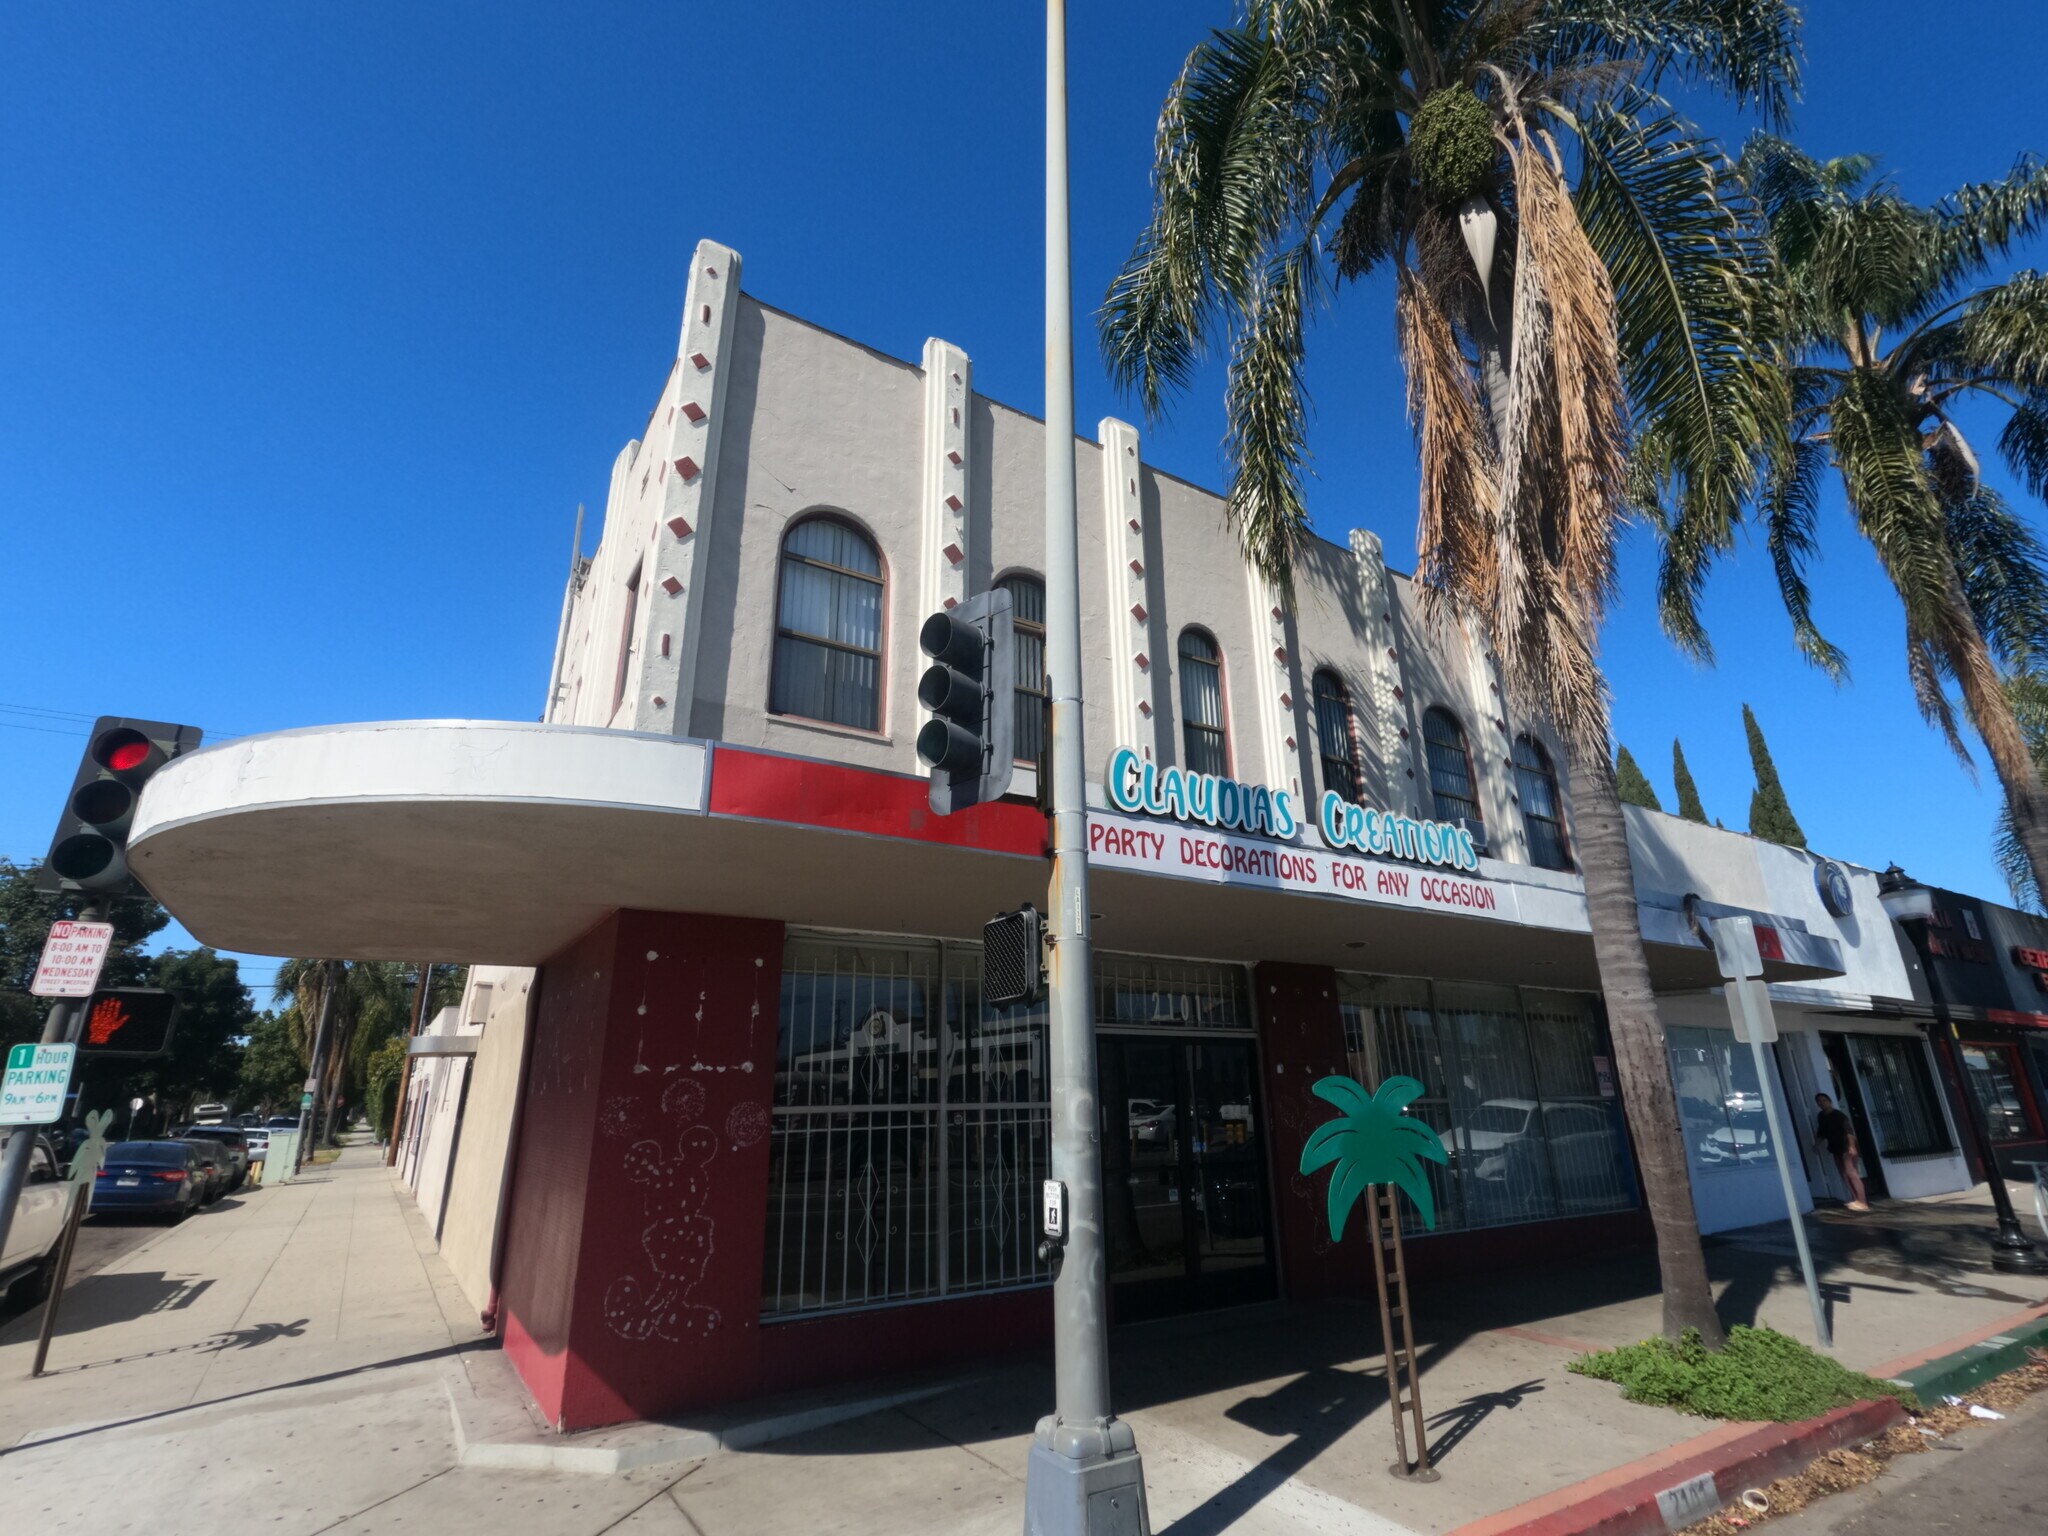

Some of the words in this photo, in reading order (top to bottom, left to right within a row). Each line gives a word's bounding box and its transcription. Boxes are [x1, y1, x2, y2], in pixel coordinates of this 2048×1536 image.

[1107, 746, 1296, 839] CLAUDIAS
[1319, 790, 1478, 871] CREATIONS
[1090, 823, 1165, 860] PARTY
[1179, 837, 1317, 884] DECORATIONS
[1331, 862, 1368, 891] FOR
[1377, 869, 1409, 898] ANY
[1420, 876, 1496, 910] OCCASION
[53, 923, 71, 938] NO
[70, 926, 110, 939] PARKING
[51, 942, 73, 952] 8:00
[75, 943, 90, 953] AM
[91, 944, 103, 953] TO
[51, 955, 78, 964] 10:00
[79, 956, 94, 965] AM
[41, 967, 96, 978] WEDNESDAY
[1151, 991, 1202, 1022] 2101
[18, 1048, 27, 1066] 1
[35, 1051, 69, 1065] HOUR
[7, 1069, 67, 1086] PARKING
